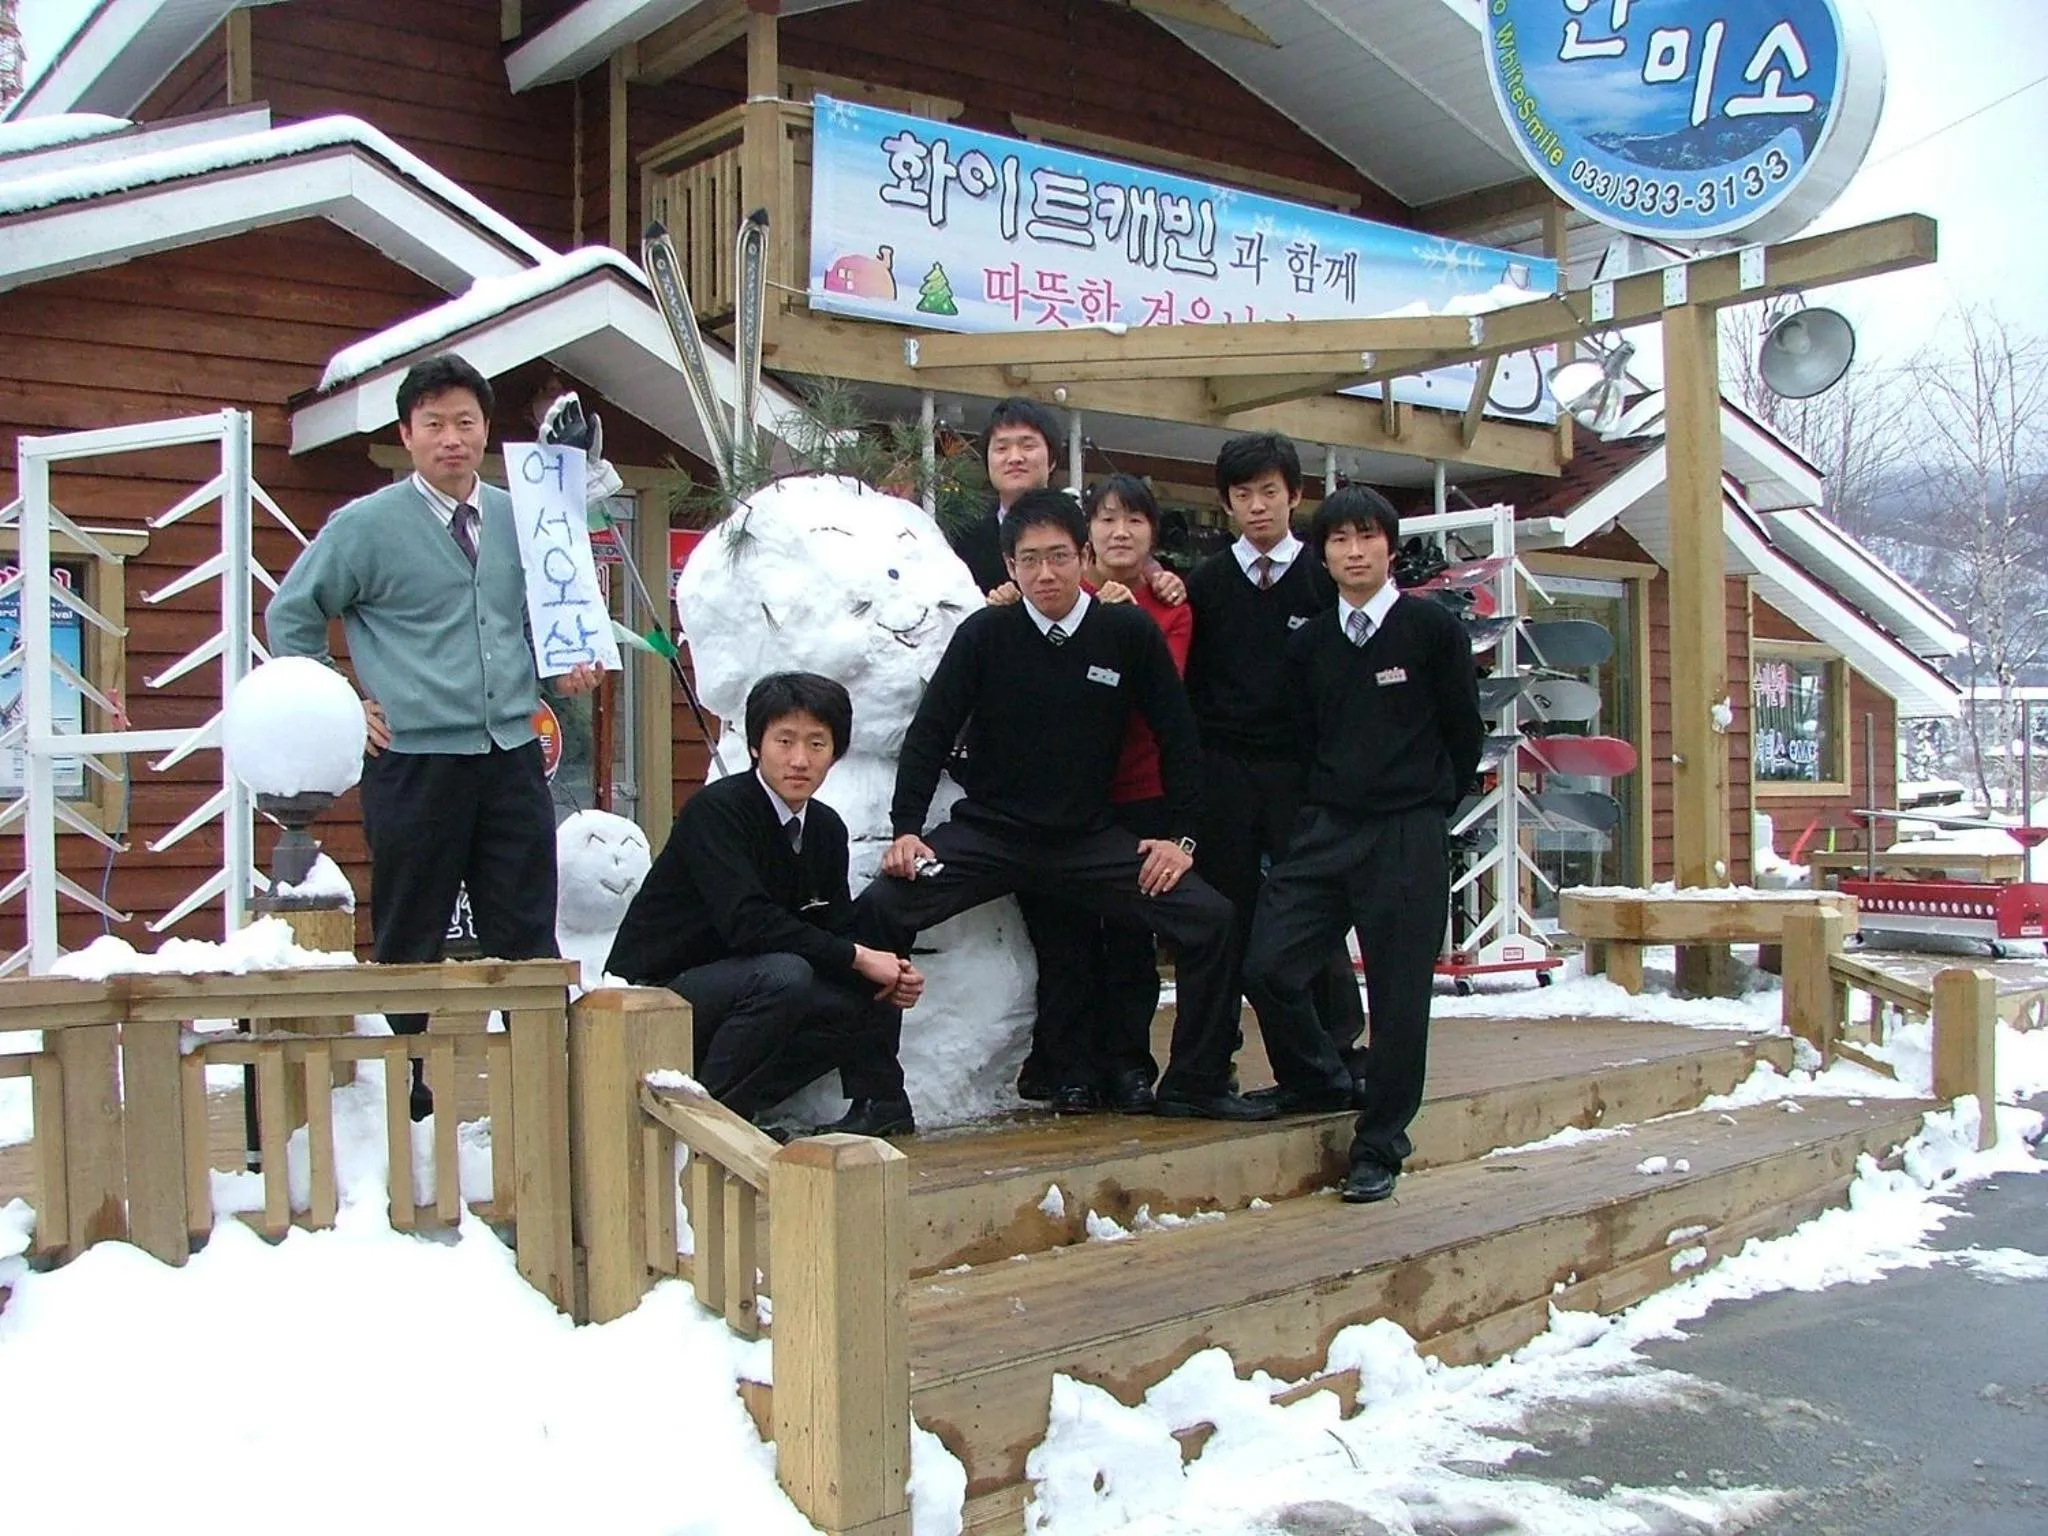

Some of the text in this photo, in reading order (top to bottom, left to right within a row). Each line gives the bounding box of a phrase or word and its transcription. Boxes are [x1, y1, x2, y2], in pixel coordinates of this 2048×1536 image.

[1570, 149, 1790, 216] 033)333-3133
[983, 262, 1122, 328] 따뜻한
[1286, 242, 1358, 305] 함께
